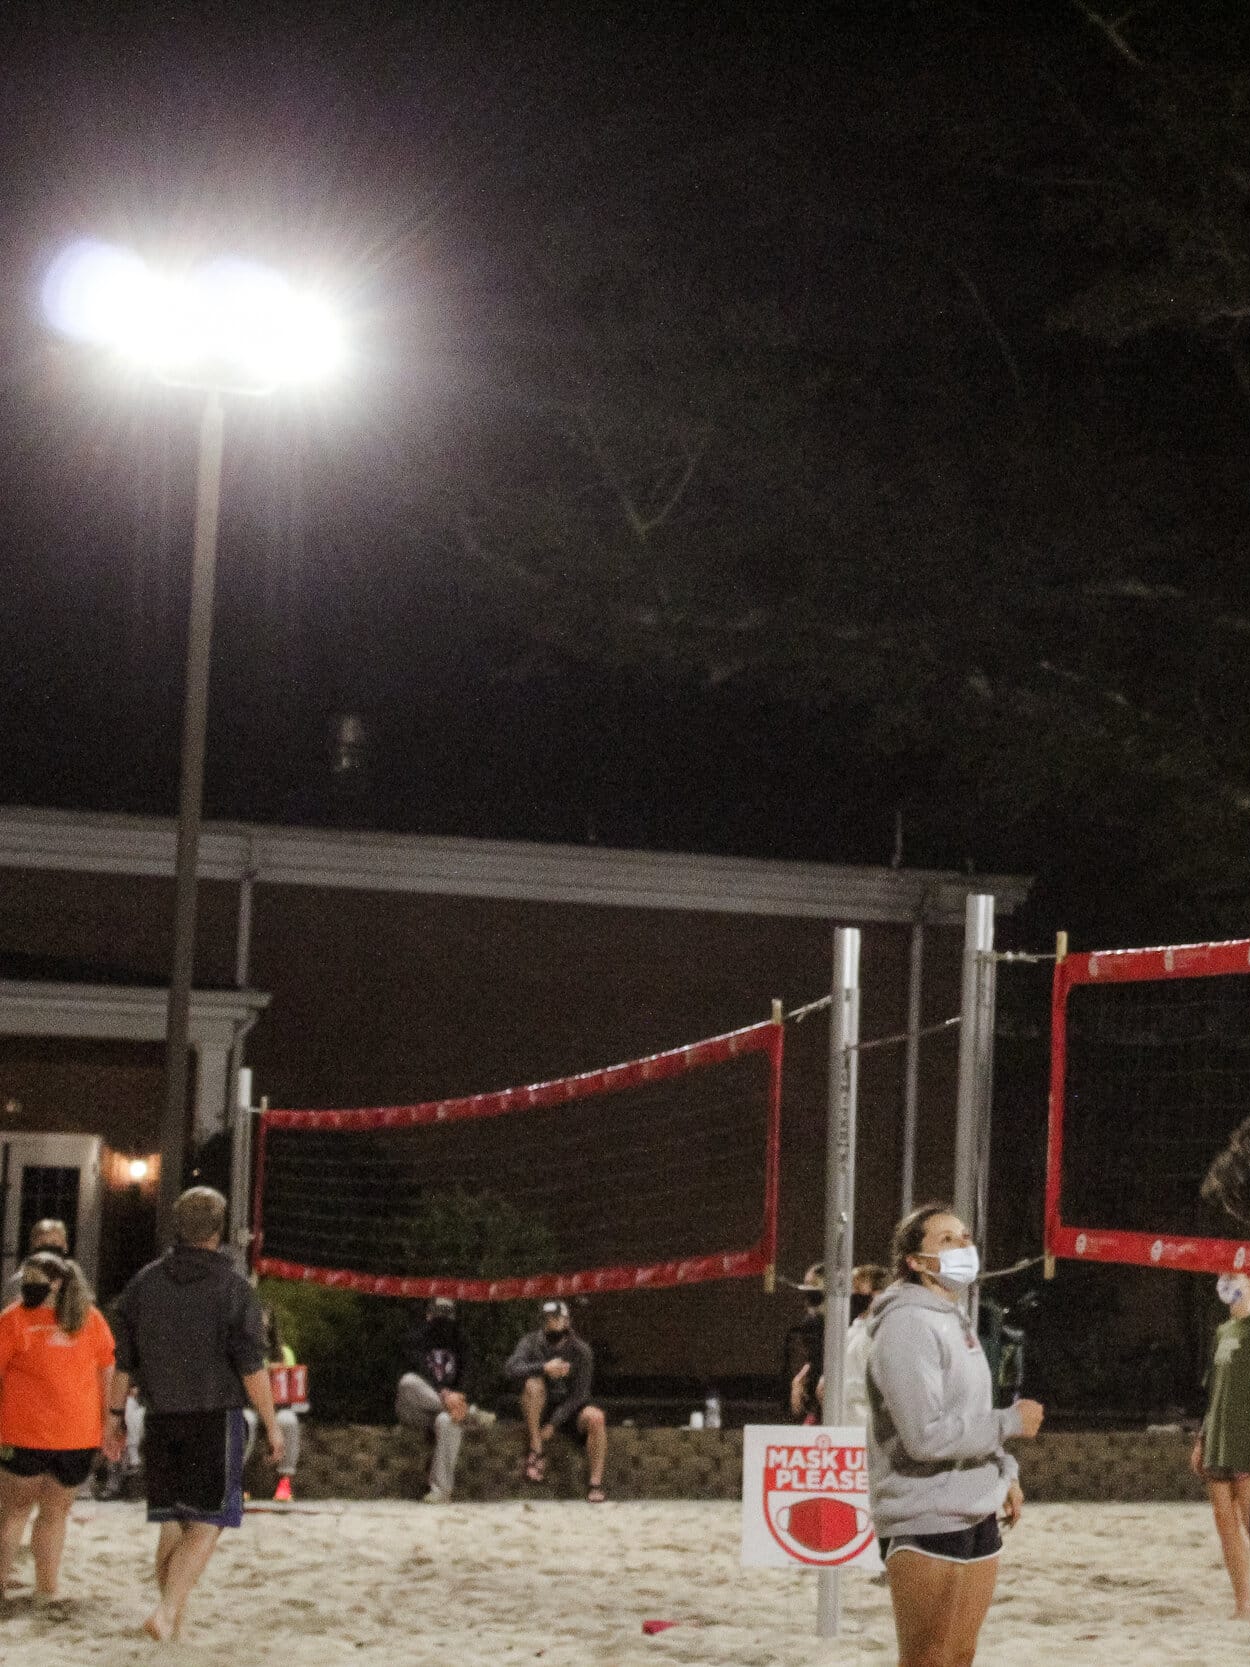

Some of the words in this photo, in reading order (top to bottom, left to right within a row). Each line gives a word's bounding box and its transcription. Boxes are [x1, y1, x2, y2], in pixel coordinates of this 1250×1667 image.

[768, 1449, 839, 1469] MASK
[845, 1450, 868, 1470] U
[776, 1469, 869, 1489] PLEASE
